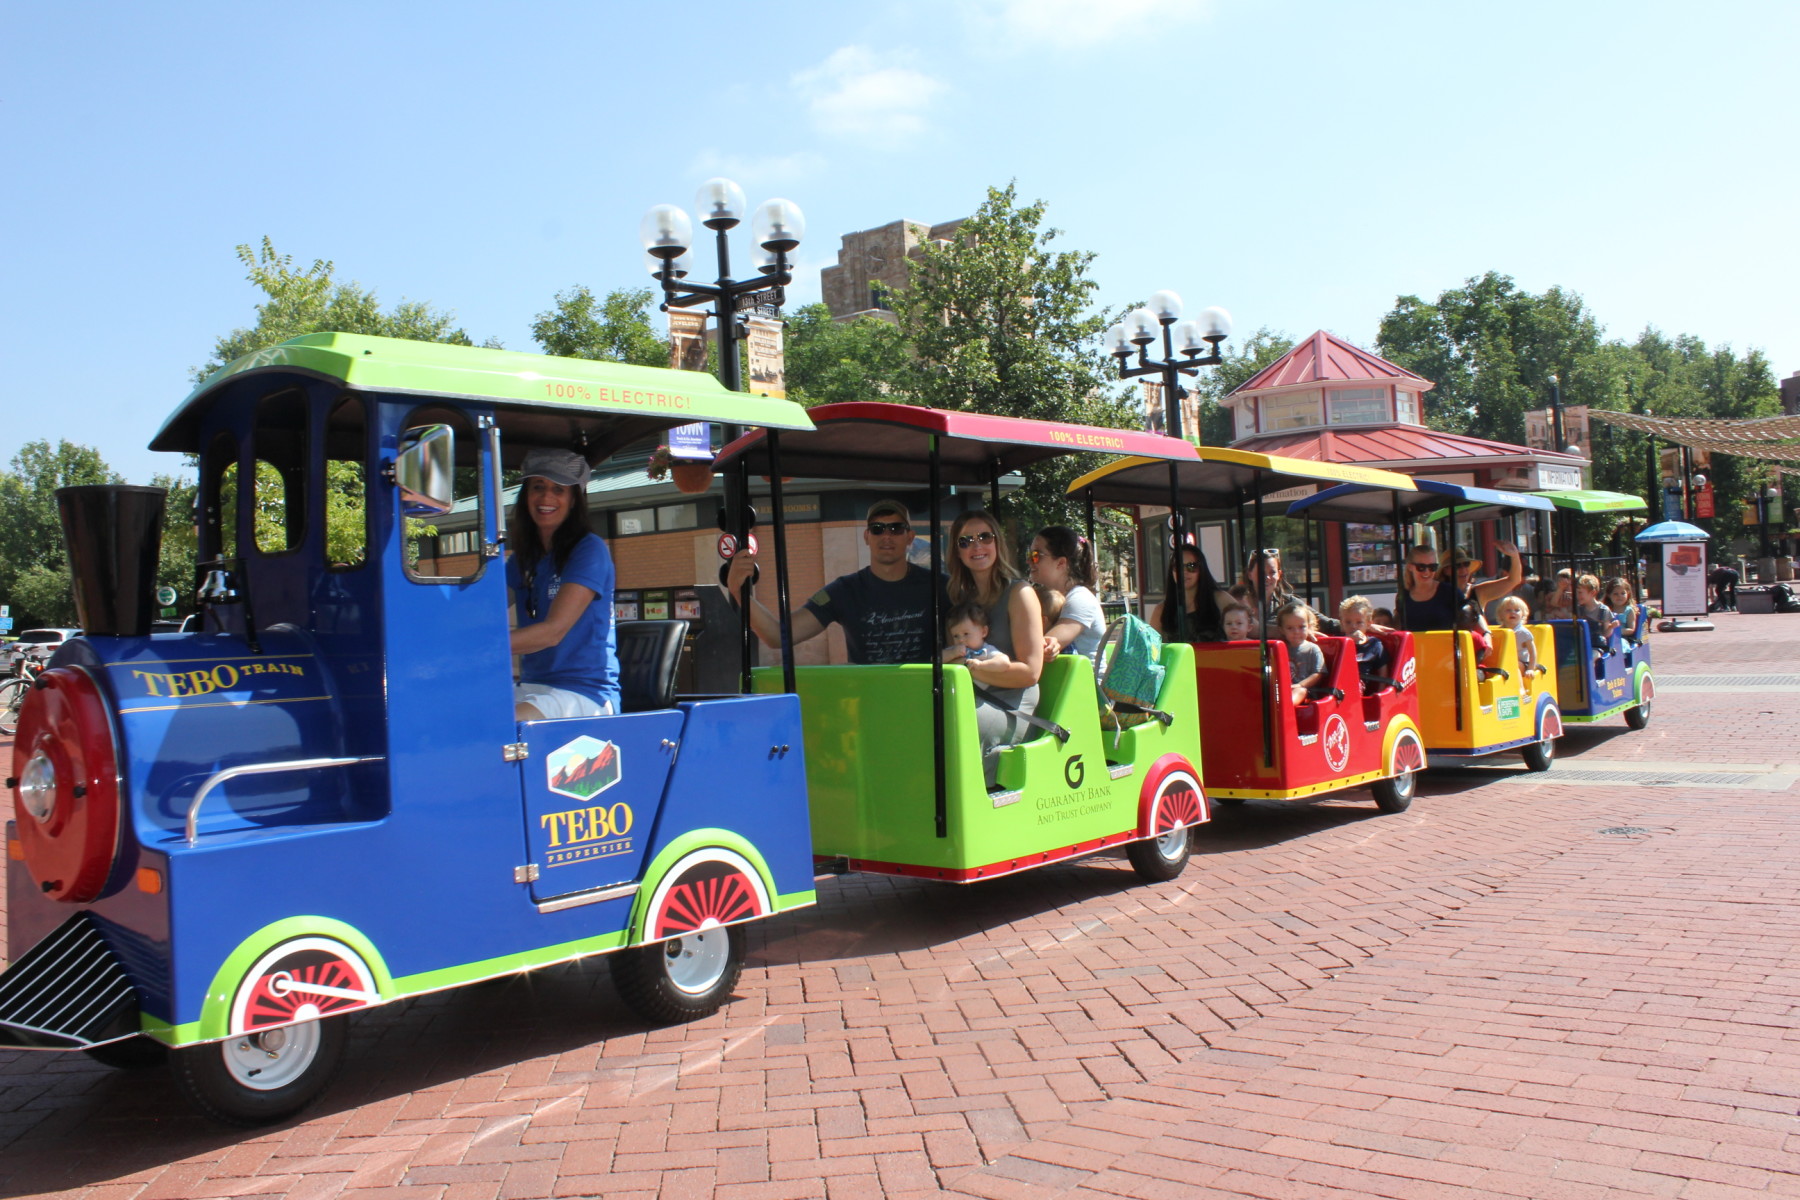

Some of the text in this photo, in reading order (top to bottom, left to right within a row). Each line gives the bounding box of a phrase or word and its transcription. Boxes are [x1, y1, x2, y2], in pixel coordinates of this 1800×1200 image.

[756, 290, 777, 303] STREET
[757, 306, 775, 317] STREET
[545, 384, 691, 409] 100% ELECTRIC!
[1049, 430, 1124, 448] 100% ELECTRIC!
[131, 663, 304, 698] TEBO TRAIN
[1402, 656, 1416, 681] GO
[1036, 785, 1112, 811] GUARANTY BANK
[540, 802, 633, 847] TEBO
[1037, 801, 1113, 825] AND TRUST COMPANY
[547, 841, 631, 863] PROPERTIES
